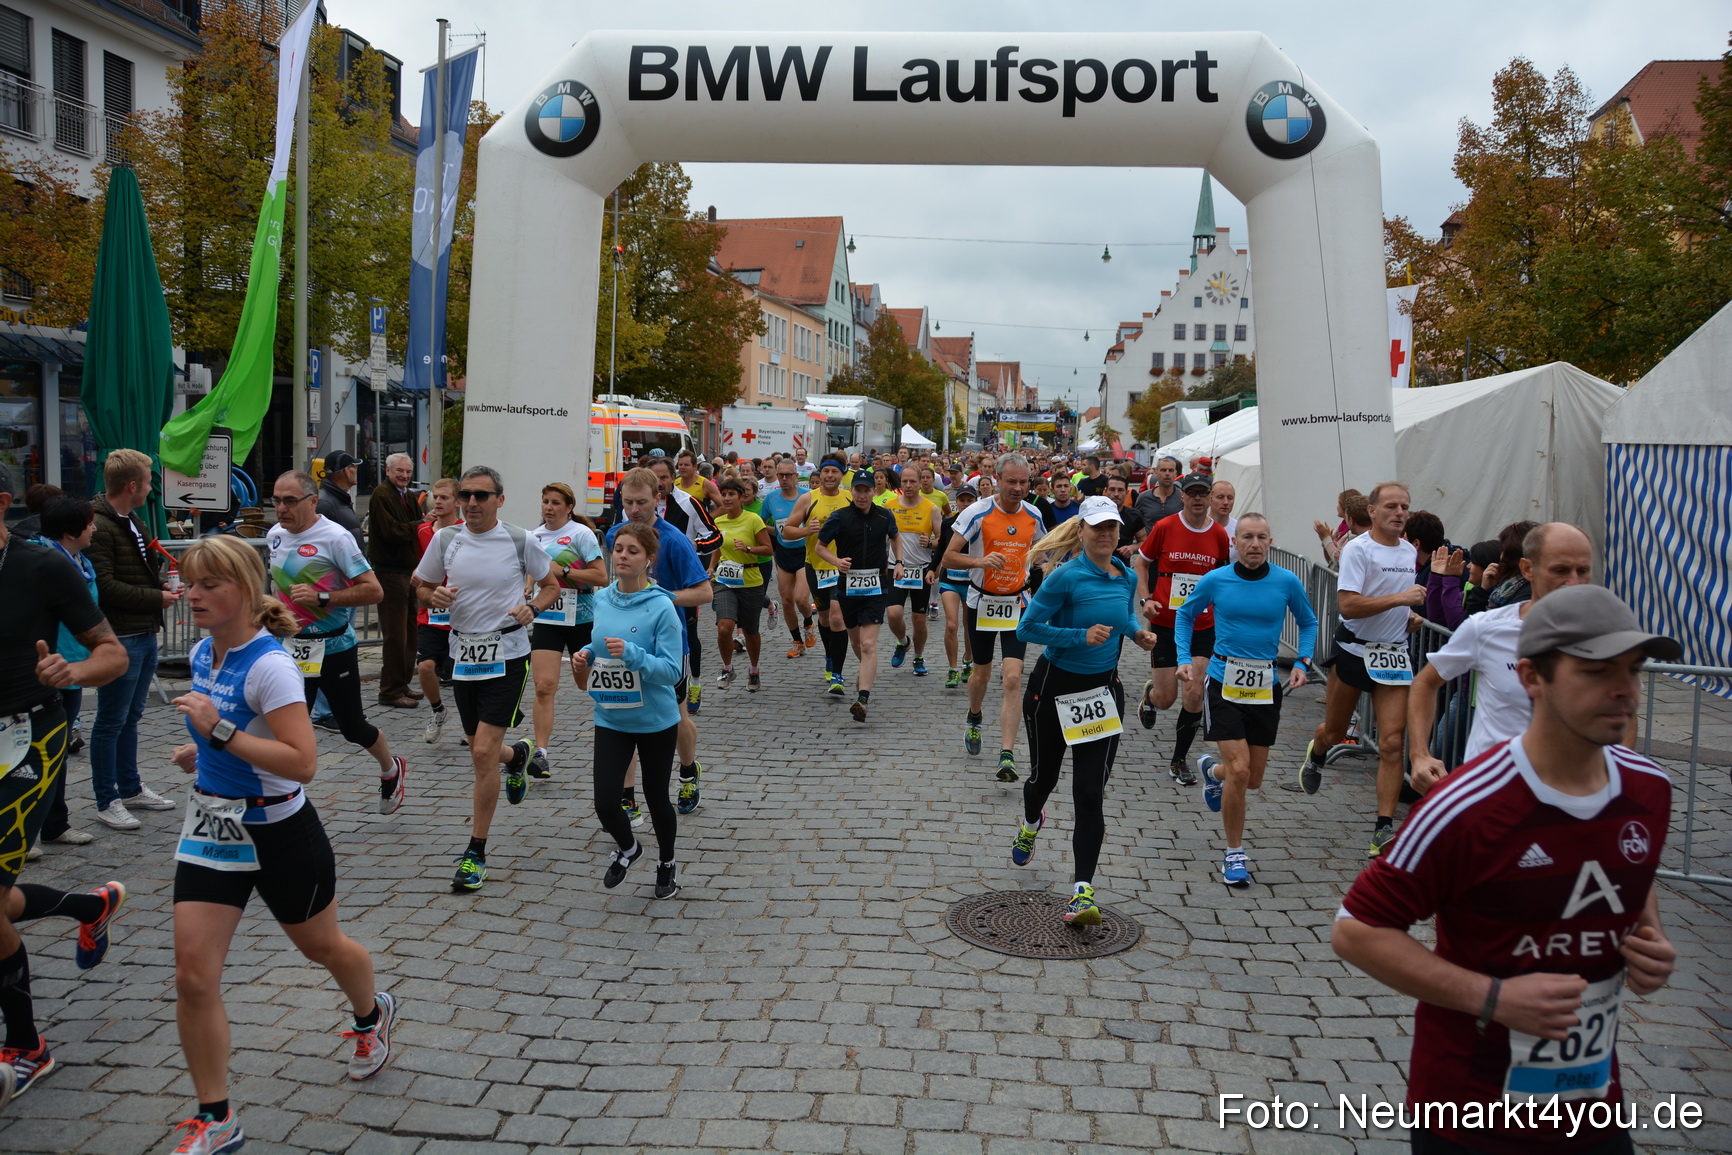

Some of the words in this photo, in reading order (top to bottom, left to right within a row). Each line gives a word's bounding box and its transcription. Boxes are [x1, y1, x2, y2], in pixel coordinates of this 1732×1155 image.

[628, 45, 833, 101] BMW
[852, 45, 1219, 118] Laufsport
[535, 82, 594, 106] BMW
[1253, 82, 1317, 108] BMW
[373, 306, 382, 329] P
[312, 355, 319, 383] P
[334, 402, 340, 414] 3
[466, 403, 568, 417] www.bmw-laufsport.de
[1281, 412, 1391, 426] www.bmw-laufsport.de
[177, 480, 216, 489] Kaserngasse
[1169, 552, 1211, 563] NEUMARKT
[719, 566, 740, 578] 2567
[850, 576, 877, 588] 2750
[986, 604, 1013, 618] 540
[460, 643, 498, 662] 2427
[1368, 652, 1407, 669] 2509
[464, 666, 495, 674] Reinhard
[1375, 671, 1404, 680] Wolfgang
[591, 670, 635, 689] 2659
[1234, 669, 1264, 687] 281
[599, 694, 629, 702] Vanessa
[1070, 700, 1106, 724] 348
[1081, 724, 1104, 736] Heidi
[11, 772, 38, 780] adidas
[1622, 838, 1648, 855] FCN
[1518, 857, 1554, 868] adidas
[1511, 924, 1636, 960] AREV
[1555, 1071, 1599, 1088] Peter
